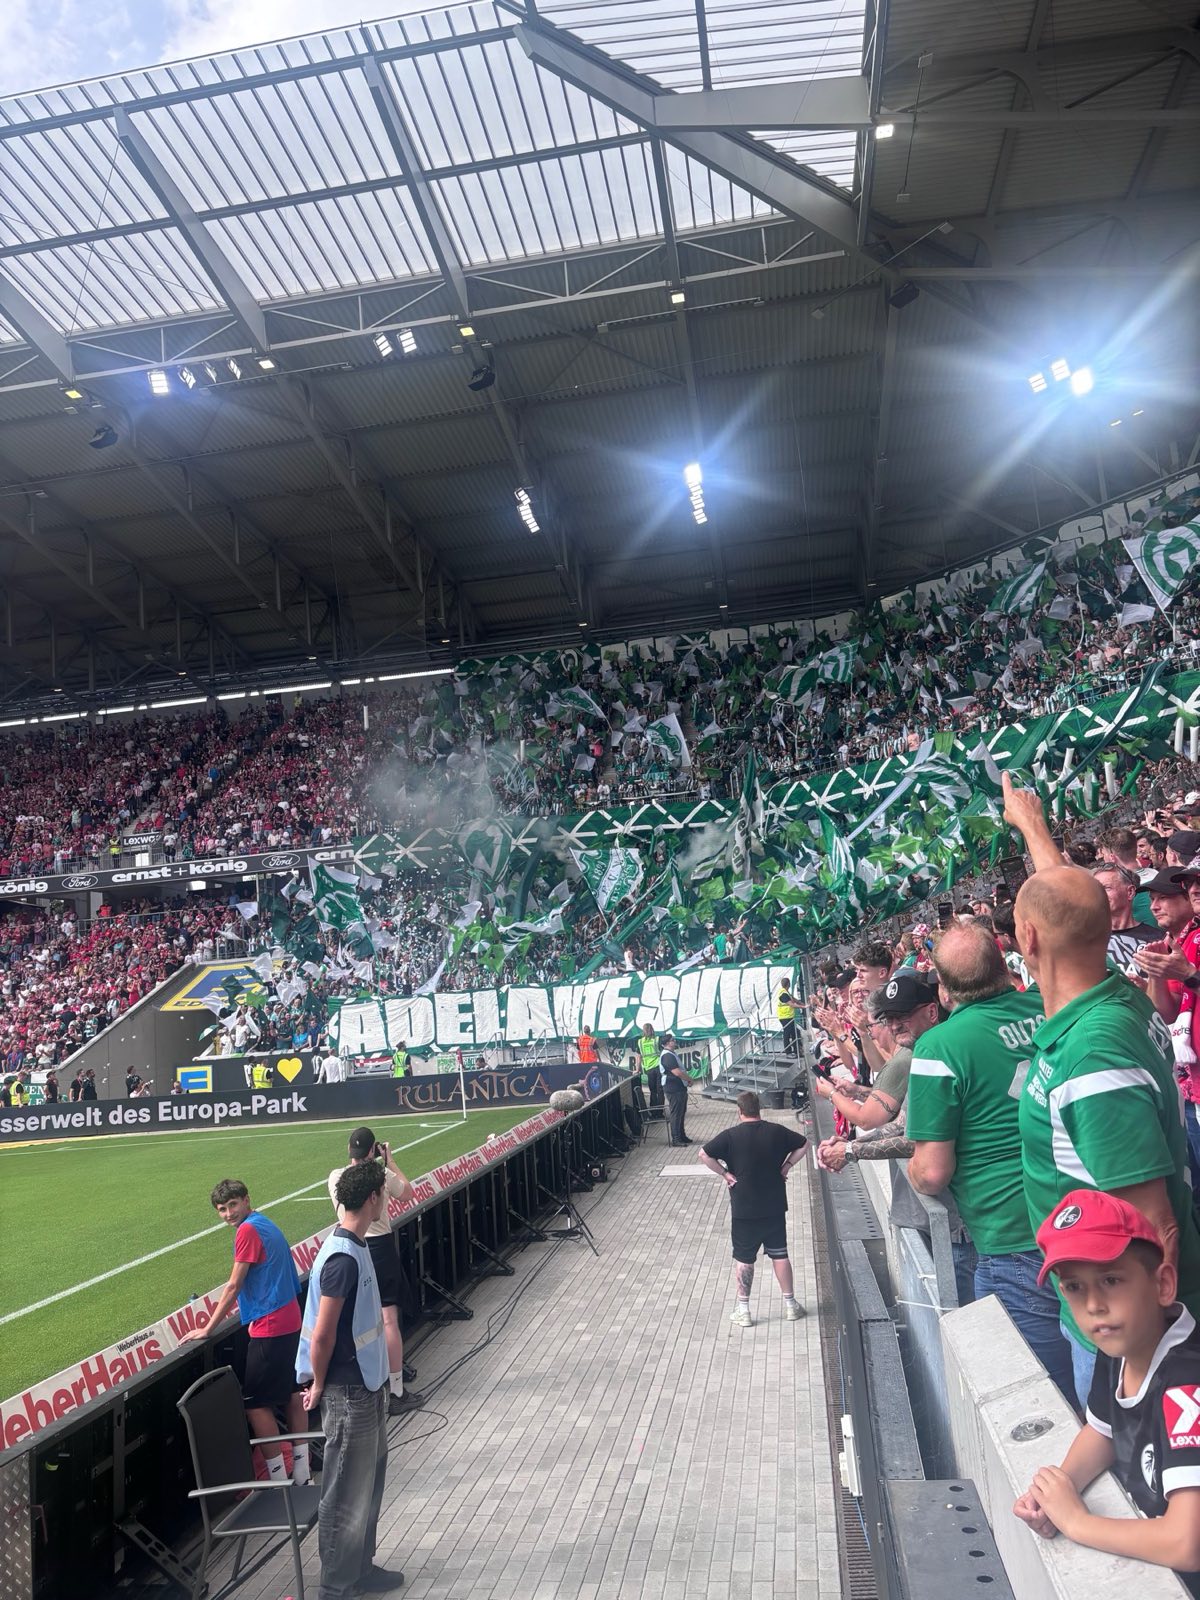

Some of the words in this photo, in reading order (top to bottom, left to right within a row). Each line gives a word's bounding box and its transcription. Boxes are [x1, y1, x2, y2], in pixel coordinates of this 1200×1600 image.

[112, 866, 172, 884] ernst
[173, 867, 188, 877] +
[189, 858, 248, 875] könig
[268, 855, 293, 867] Ford
[0, 879, 48, 894] önig
[68, 876, 92, 888] Ford
[394, 1069, 550, 1112] RULANTICA
[0, 1106, 103, 1133] sserwelt
[108, 1104, 151, 1125] des
[158, 1092, 308, 1124] Europa-Park
[432, 1156, 485, 1190] WeberHaus
[117, 1330, 155, 1353] WeberHaus.de
[0, 1339, 164, 1450] eberHaus
